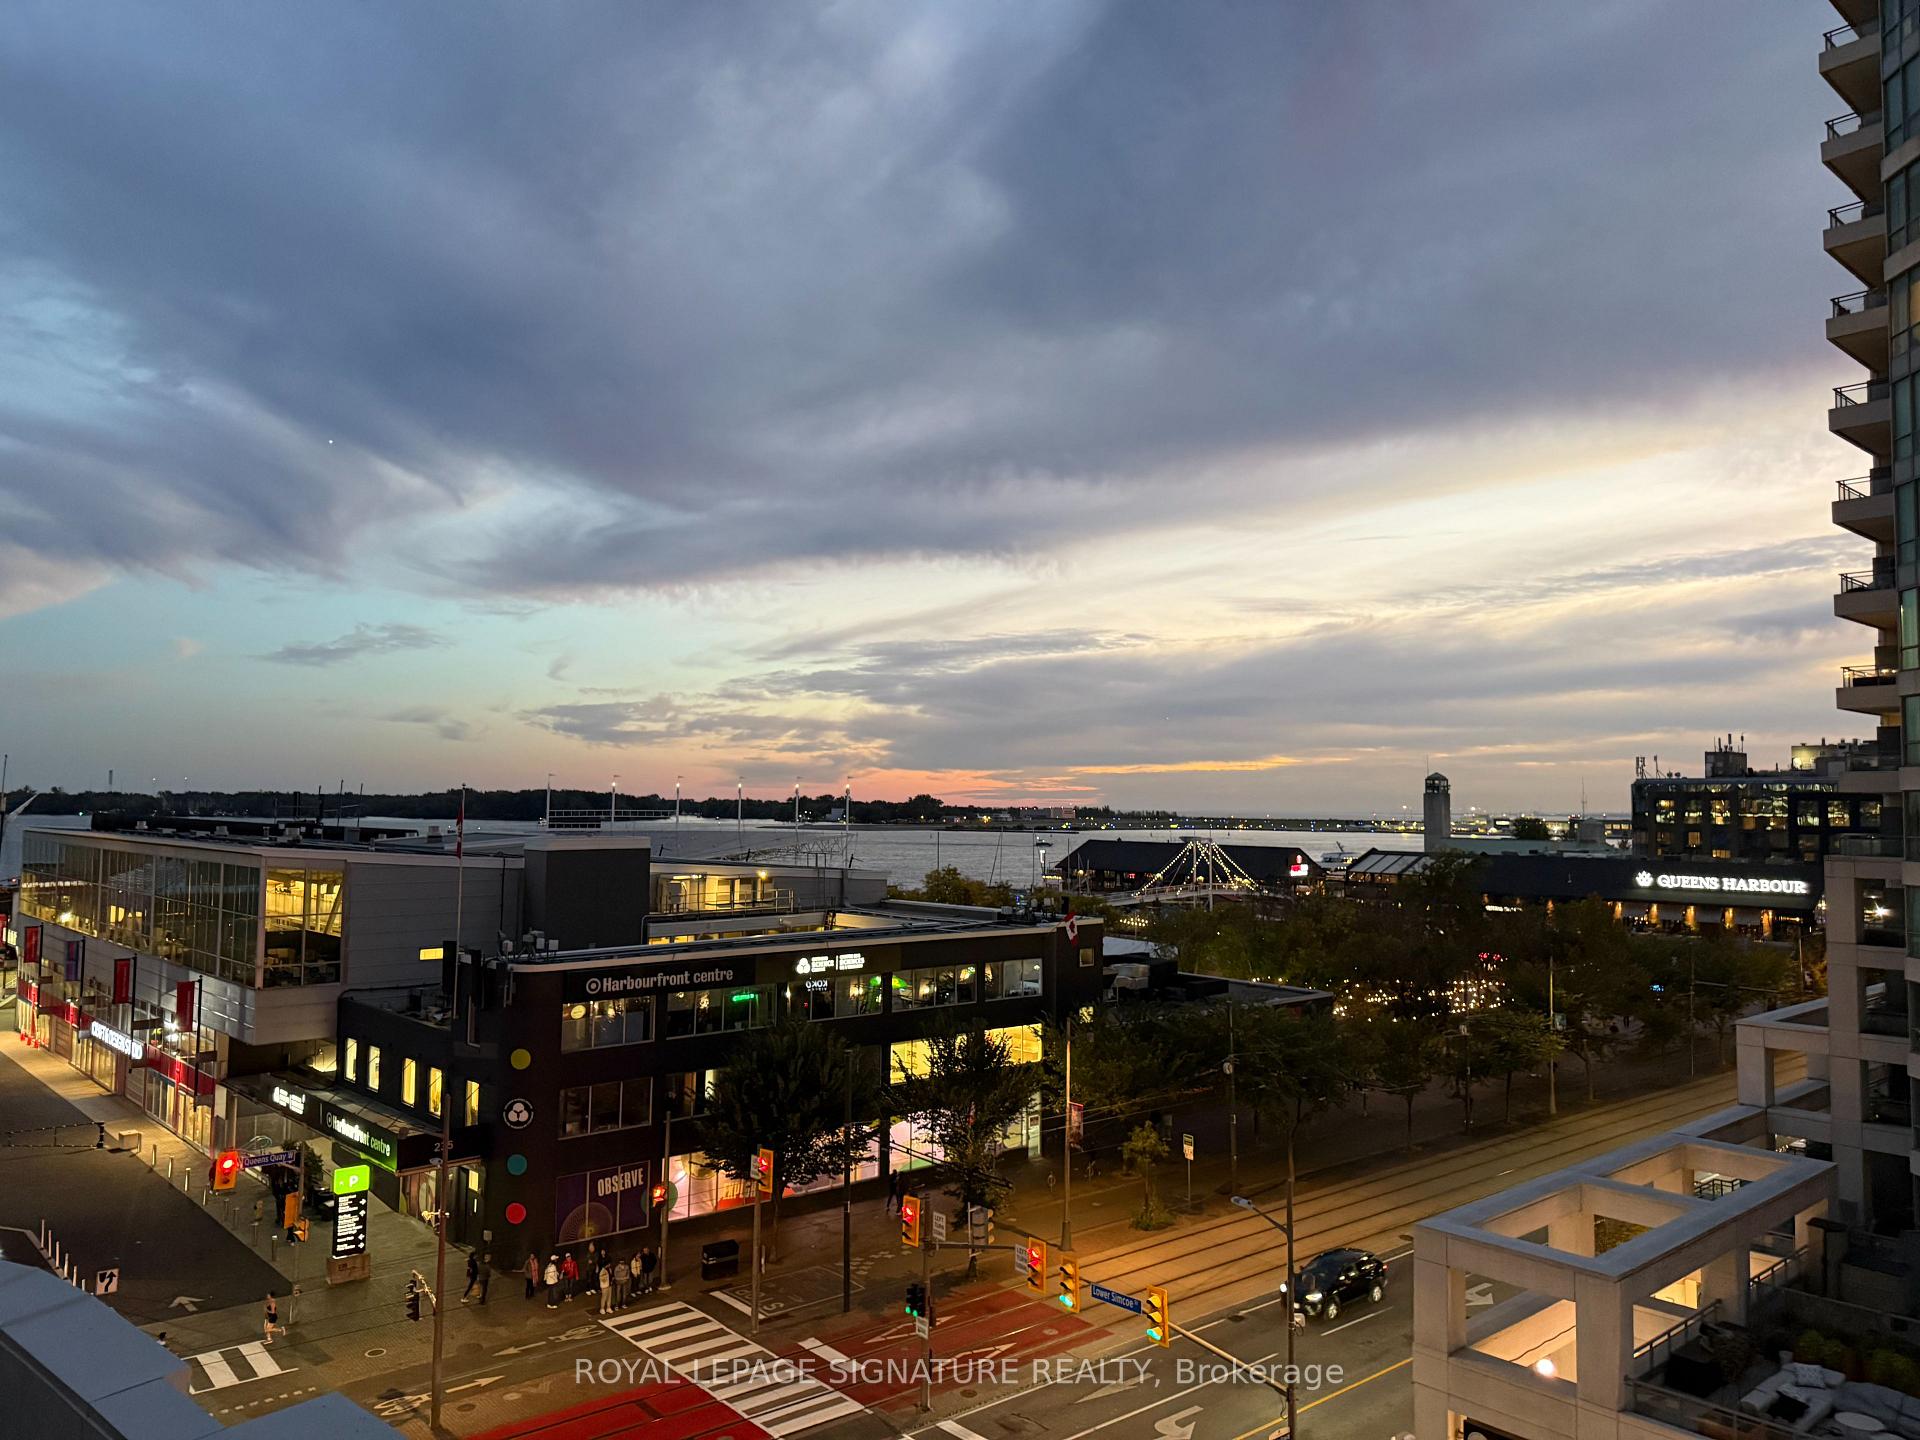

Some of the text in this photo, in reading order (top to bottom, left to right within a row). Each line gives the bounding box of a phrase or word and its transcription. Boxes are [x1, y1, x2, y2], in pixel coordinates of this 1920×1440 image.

[1657, 875, 1808, 894] QUEENS HARBOUR
[602, 968, 734, 992] Harbourfront centre
[332, 1114, 391, 1157] Harbourfront centre
[244, 1156, 269, 1166] Queens
[270, 1154, 287, 1162] Quay
[597, 1168, 644, 1197] OBSERVE
[1092, 1285, 1111, 1299] Lower
[1111, 1292, 1134, 1309] Simcoe
